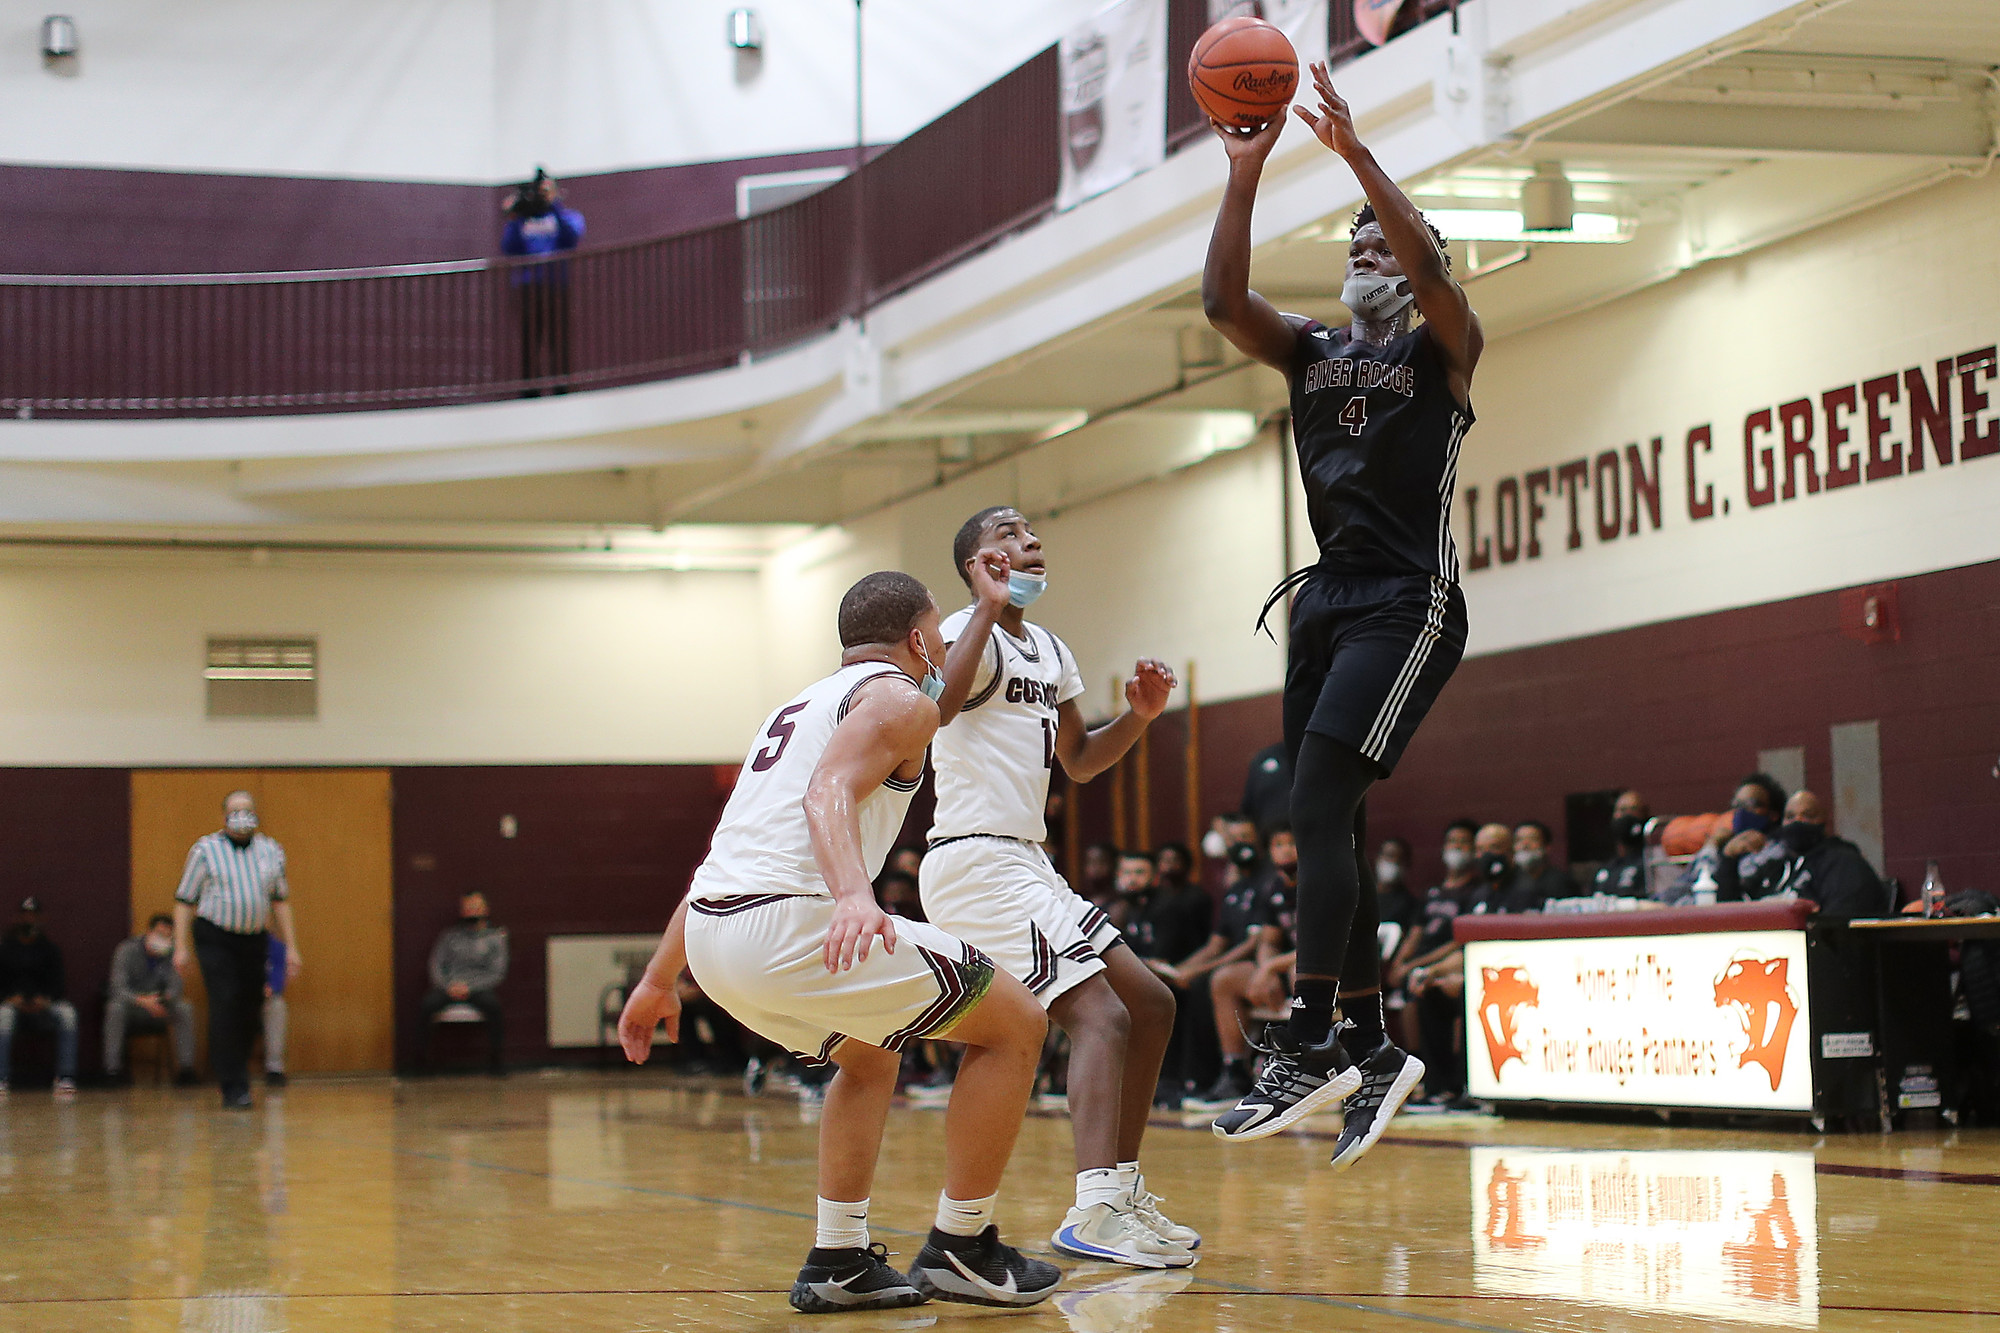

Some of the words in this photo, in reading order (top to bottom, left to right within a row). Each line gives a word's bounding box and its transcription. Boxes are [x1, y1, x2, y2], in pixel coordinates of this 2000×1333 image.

[1304, 357, 1354, 395] RIVER
[1356, 360, 1414, 398] ROUGE
[1338, 396, 1369, 437] 4
[1464, 436, 1664, 573] LOFTON
[1686, 423, 1729, 522] C.
[1744, 344, 2000, 509] GREENE
[750, 699, 812, 772] 5
